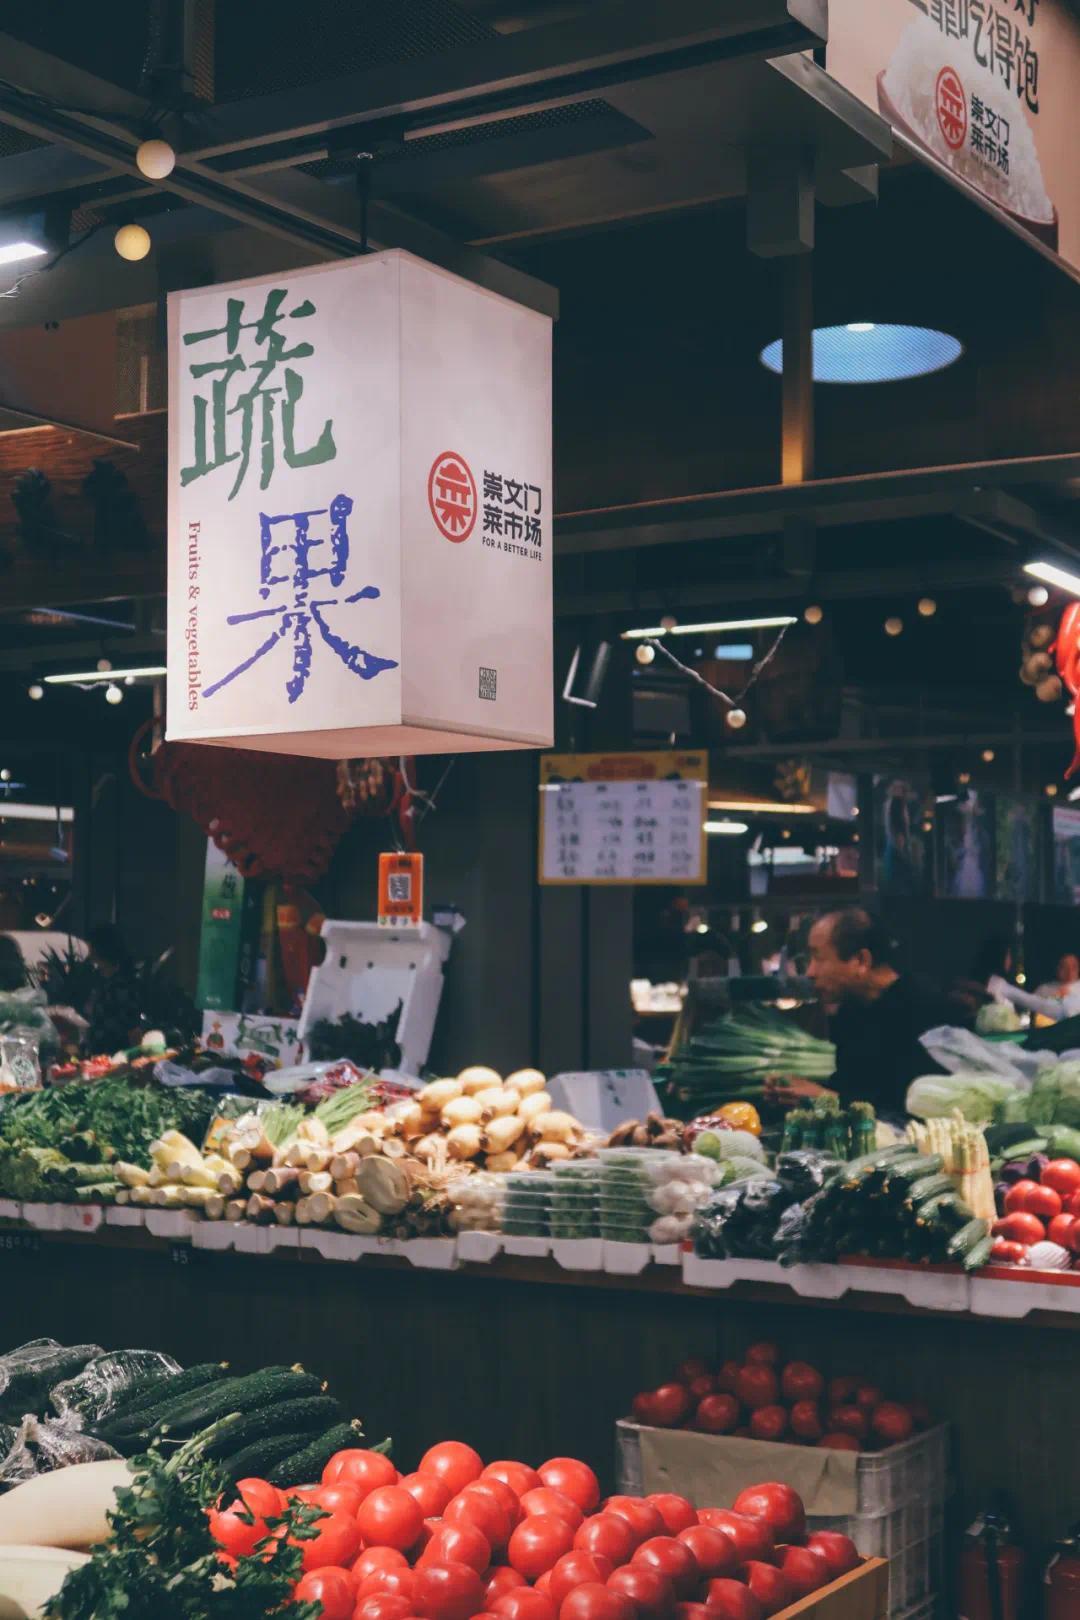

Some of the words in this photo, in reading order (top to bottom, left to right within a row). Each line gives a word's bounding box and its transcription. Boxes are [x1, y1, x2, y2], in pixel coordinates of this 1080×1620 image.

[482, 469, 542, 515] 崇文门
[482, 503, 542, 548] 菜市场
[188, 520, 202, 580] Fruits
[482, 536, 496, 549] FOR
[497, 541, 502, 550] A
[503, 542, 528, 557] BETTER
[529, 549, 543, 562] LIFE
[188, 585, 201, 601] &
[185, 606, 203, 711] vegetables
